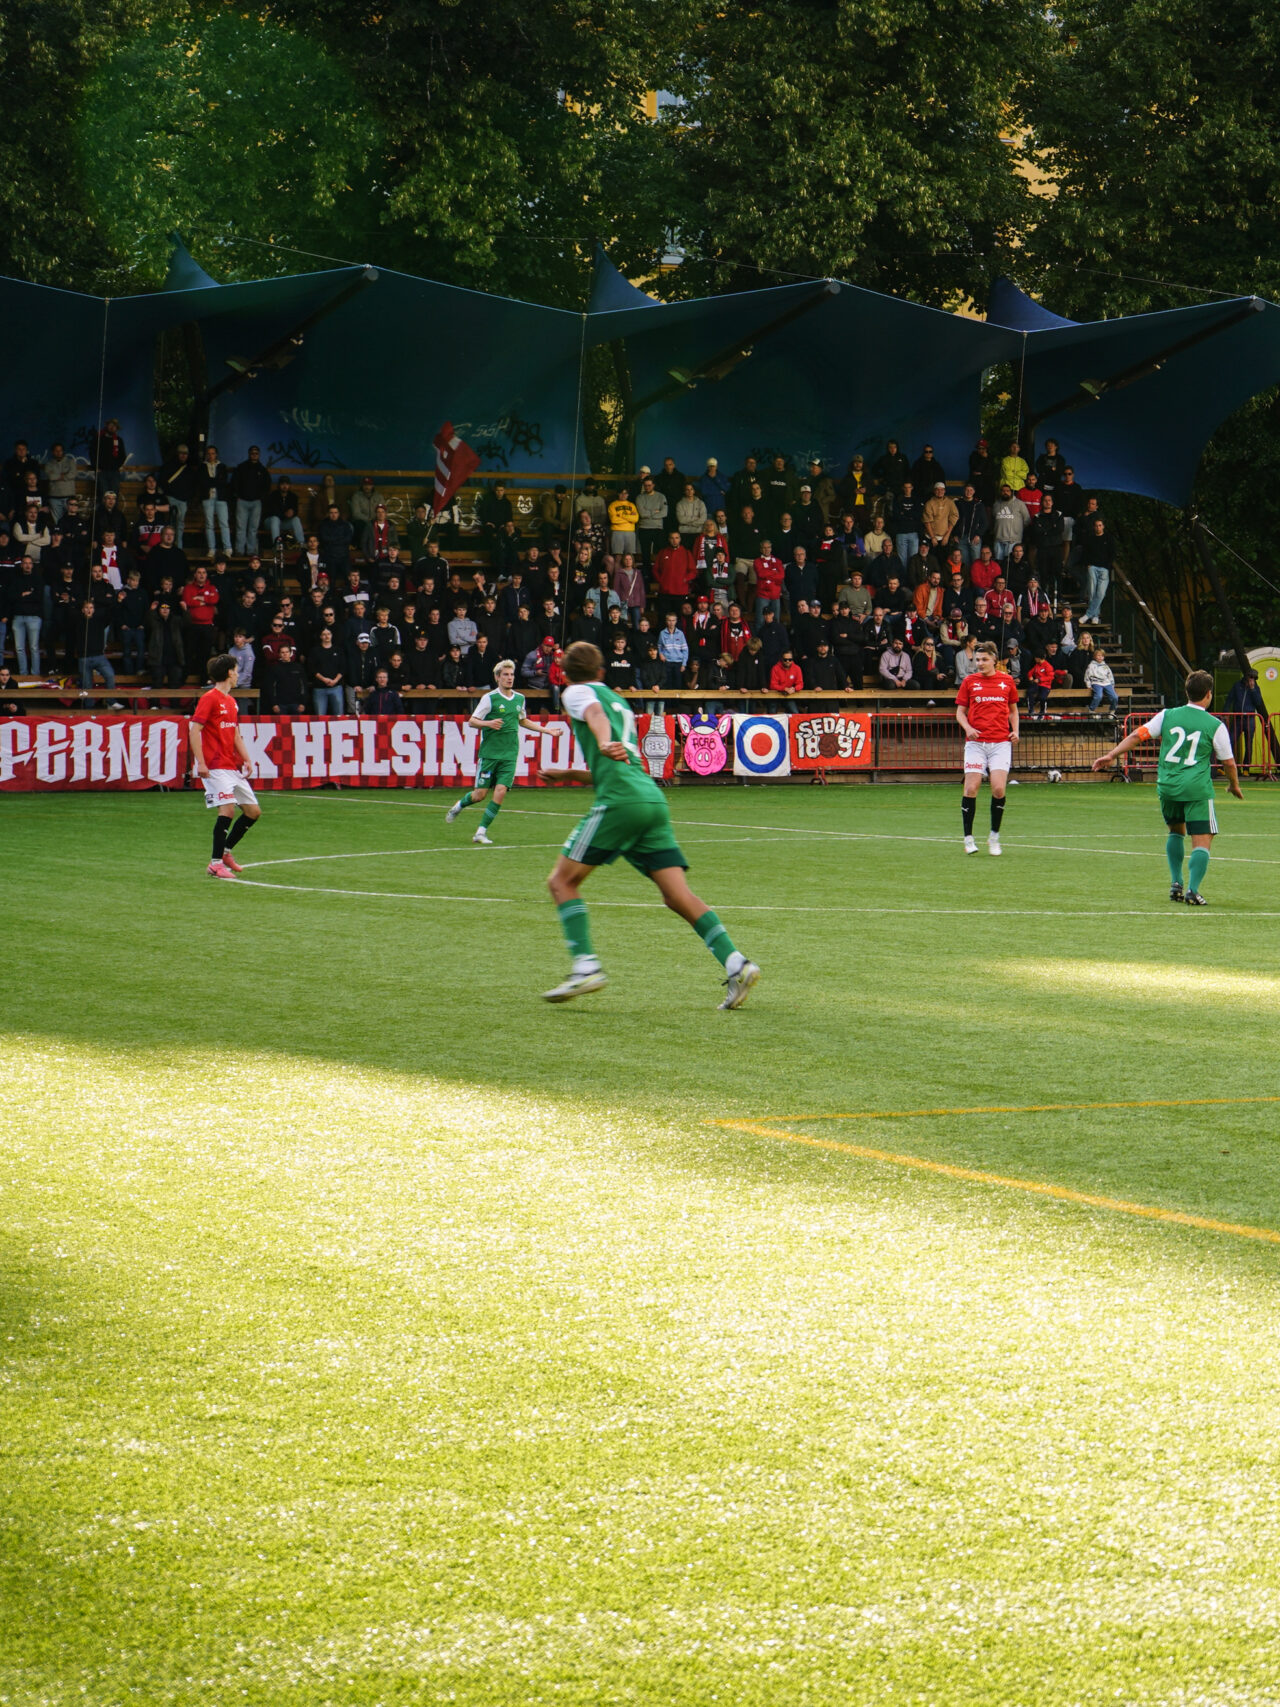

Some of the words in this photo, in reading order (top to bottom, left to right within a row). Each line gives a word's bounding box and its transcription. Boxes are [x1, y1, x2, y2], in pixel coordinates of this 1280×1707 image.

[798, 716, 862, 739] SEDAN
[1165, 726, 1202, 766] 21
[291, 720, 589, 777] HELSINFO
